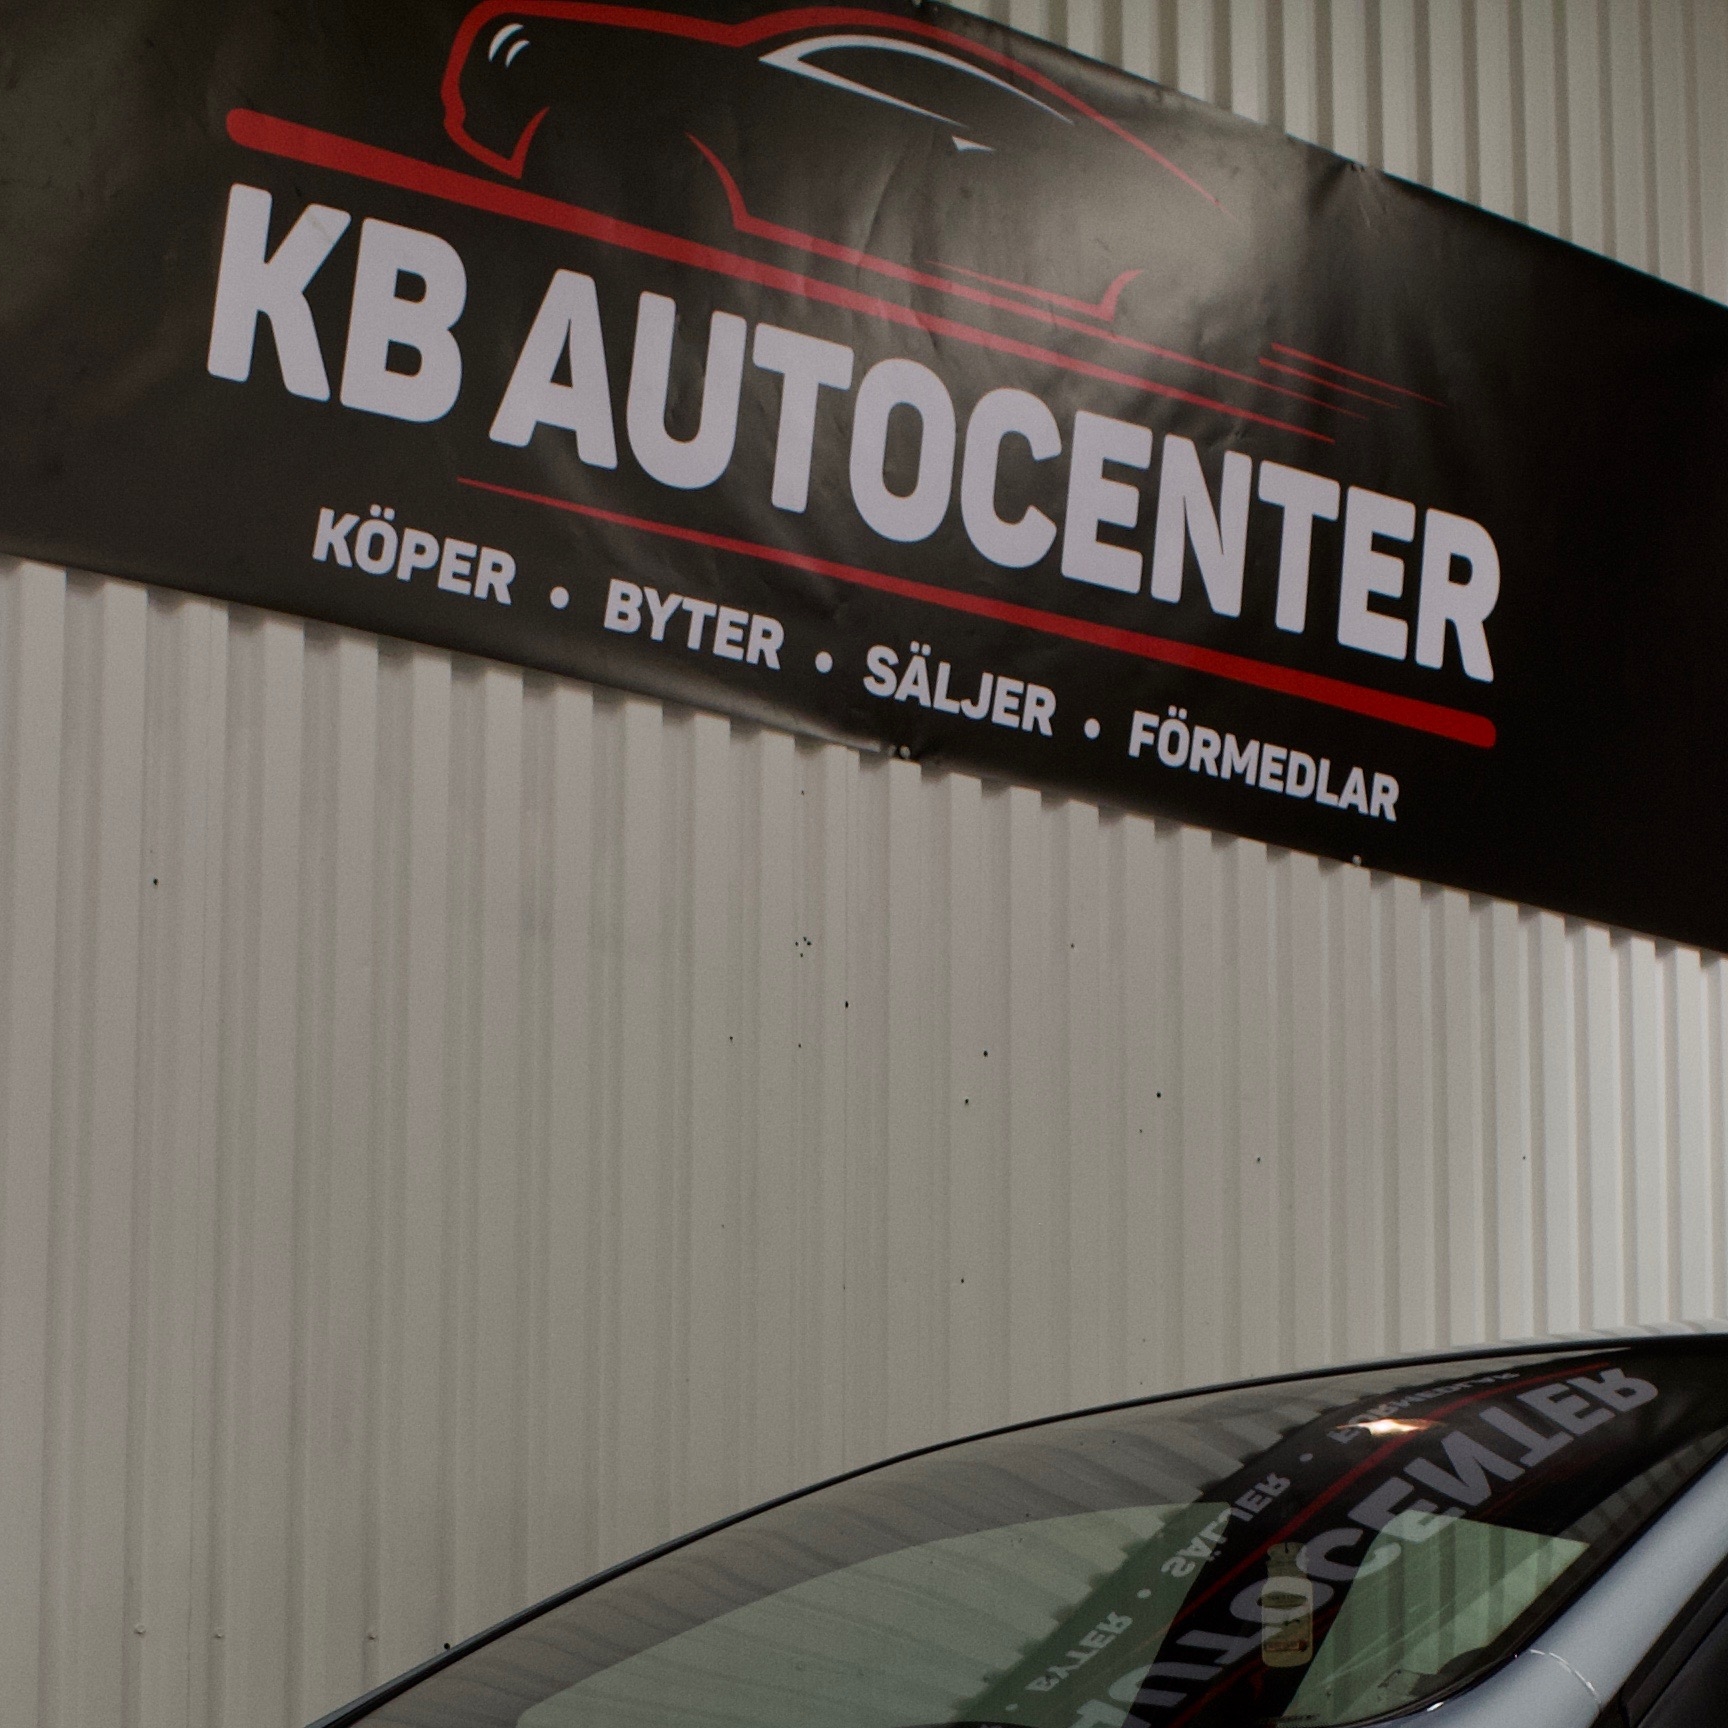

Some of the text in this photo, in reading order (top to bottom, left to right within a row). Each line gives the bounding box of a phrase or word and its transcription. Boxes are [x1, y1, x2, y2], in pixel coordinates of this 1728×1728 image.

[207, 182, 1501, 682] KB AUTOCENTER
[312, 503, 1400, 822] KÖPER BYTER SÄLJER FÖRMEDLAR
